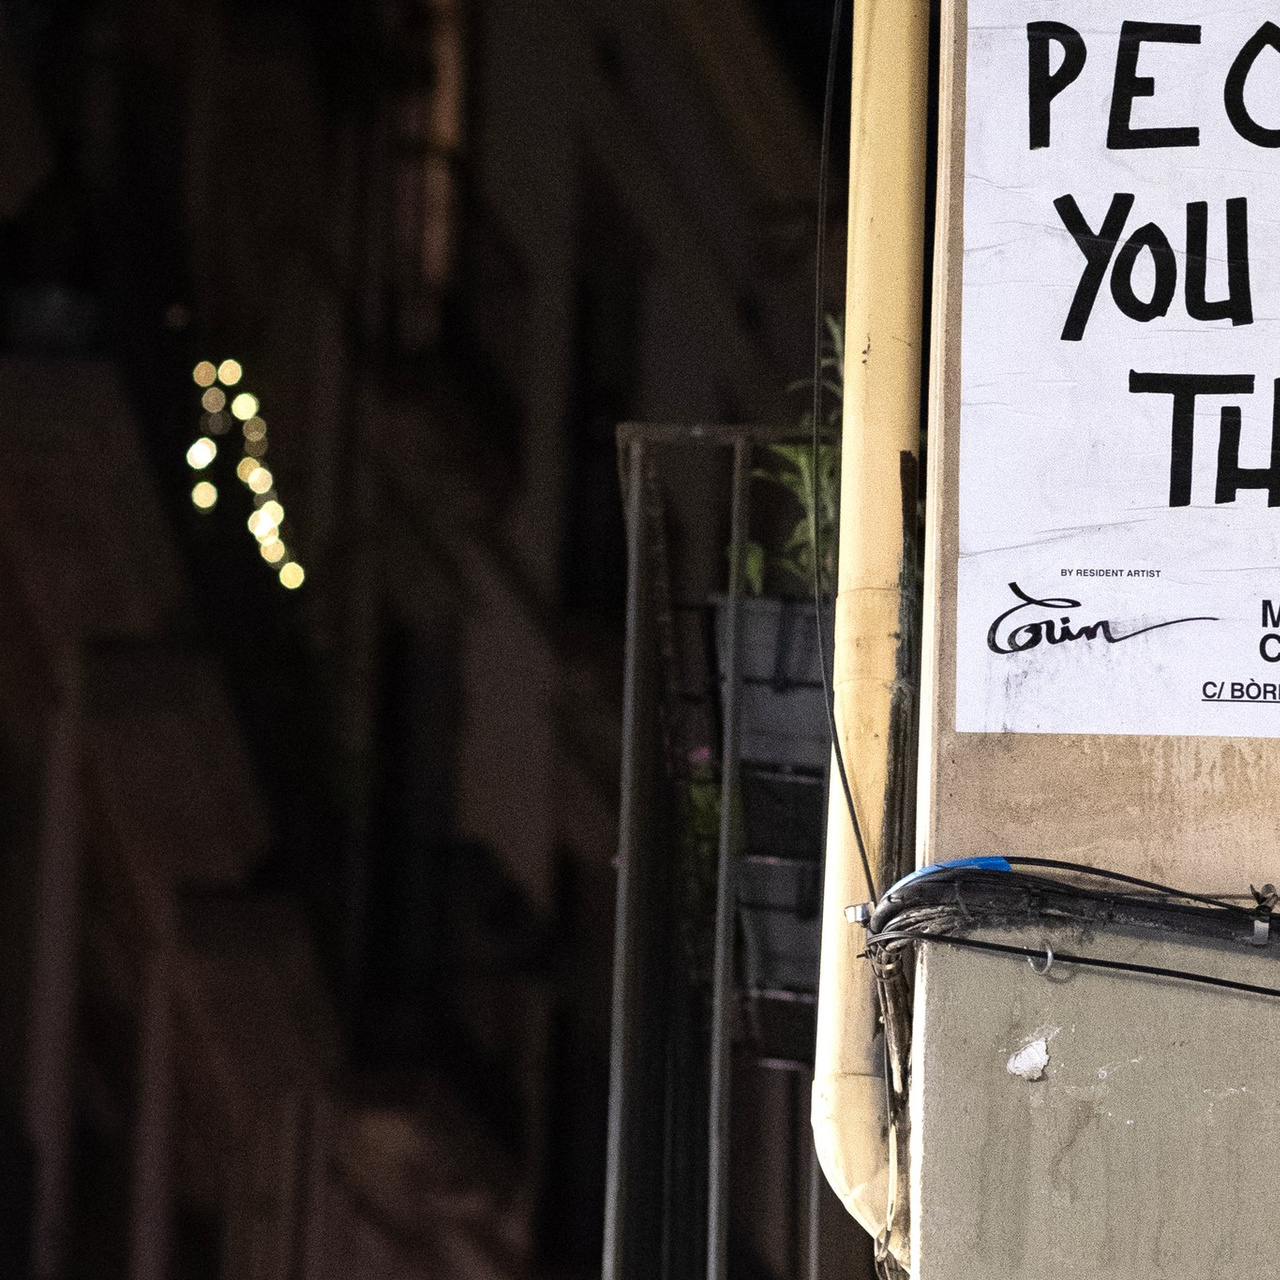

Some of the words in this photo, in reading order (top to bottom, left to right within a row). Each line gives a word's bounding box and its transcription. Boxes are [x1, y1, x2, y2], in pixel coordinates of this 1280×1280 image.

[1052, 193, 1253, 341] YOU
[1061, 569, 1073, 577] BY
[1076, 569, 1124, 577] RESIDENT
[1127, 569, 1161, 578] ARTIST
[1202, 681, 1225, 700] C/
